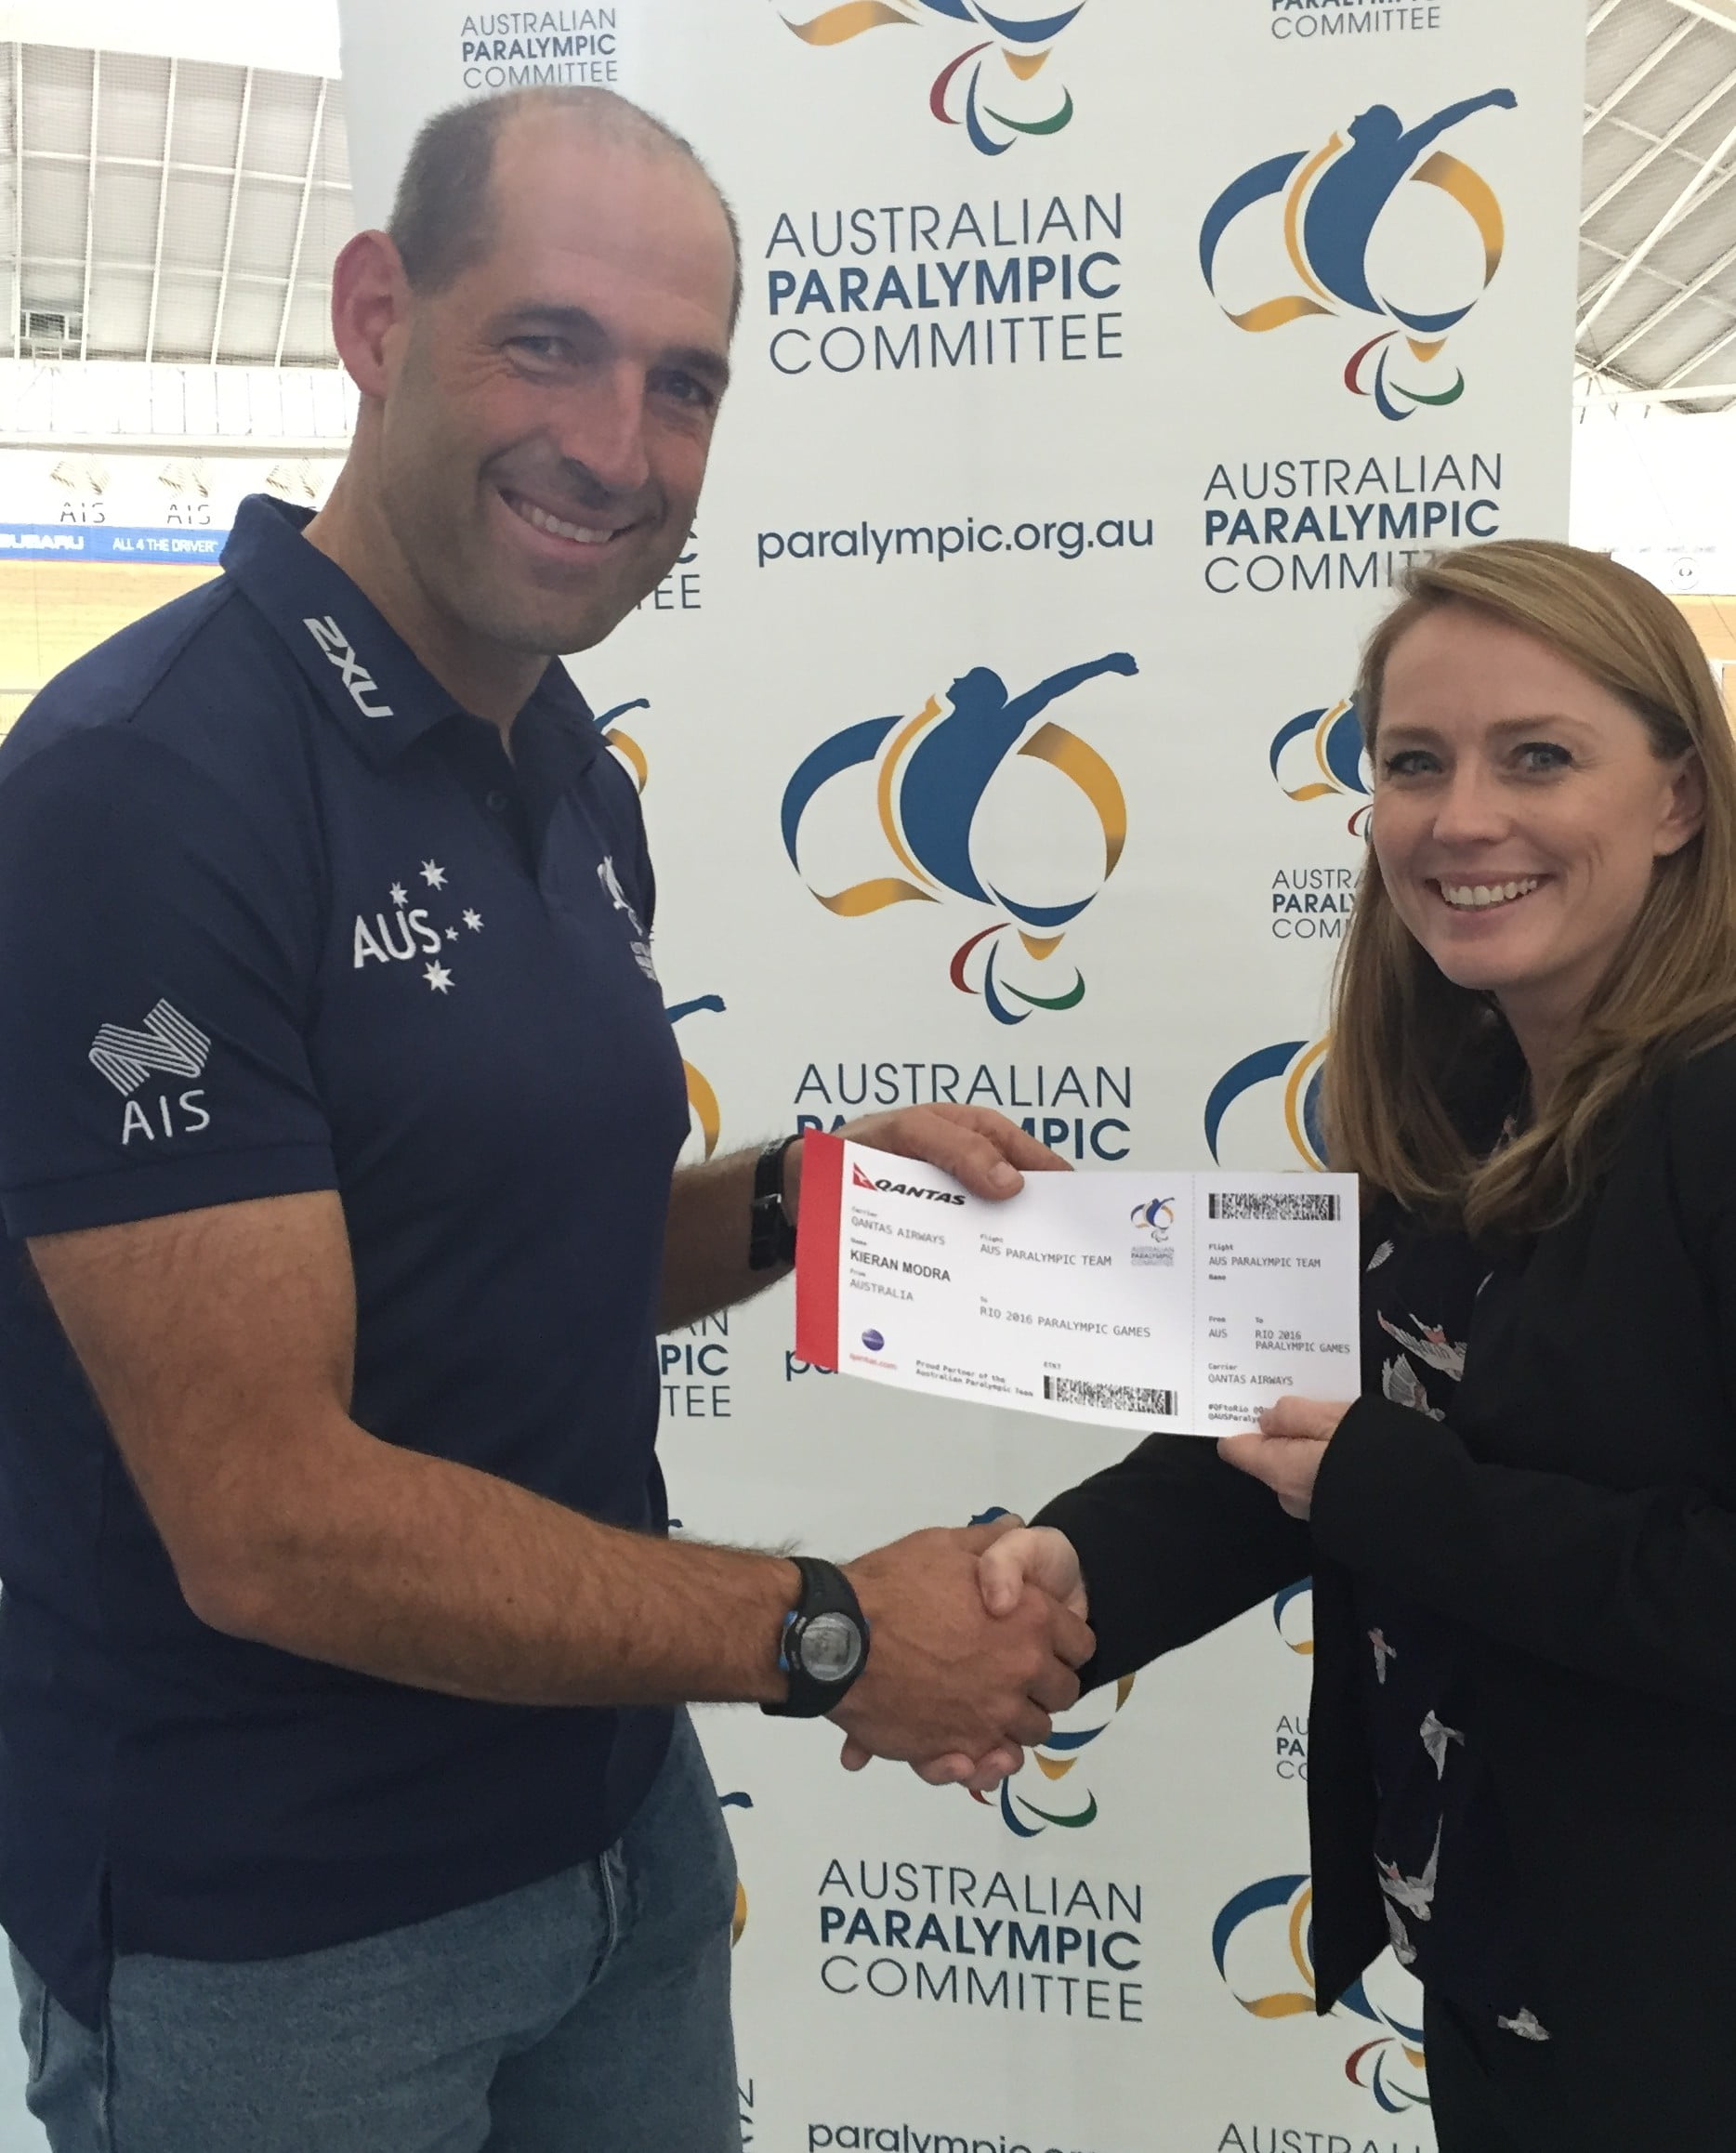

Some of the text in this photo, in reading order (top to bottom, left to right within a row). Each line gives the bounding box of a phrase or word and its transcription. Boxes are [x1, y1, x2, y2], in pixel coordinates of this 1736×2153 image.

[461, 7, 616, 36] AUSTRALIAN
[1271, 7, 1440, 39] COMMITTEE
[462, 33, 617, 62] PARALYMPIC
[463, 60, 618, 89] COMMITTEE
[765, 192, 1122, 258] AUSTRALIAN
[769, 251, 1122, 315] PARALYMPIC
[769, 312, 1123, 374] COMMITTEE
[1203, 453, 1501, 501] AUSTRALIAN
[60, 502, 105, 523] AIS
[167, 505, 211, 525] AIS
[1205, 499, 1500, 546] PARALYMPIC
[112, 537, 133, 551] ALL
[138, 538, 145, 551] 4
[147, 538, 169, 552] THE
[757, 518, 1154, 568] paralympic.org.au
[303, 616, 394, 717] 2XU
[353, 908, 441, 968] AUS
[1272, 918, 1351, 939] COM
[794, 1063, 1131, 1108] AUSTRALIAN
[122, 1089, 210, 1146] AIS
[875, 1179, 966, 1206] QANTAS
[851, 1215, 946, 1245] QANTAS AIRWAYS
[850, 1249, 951, 1282] KIERAN MODRA
[980, 1243, 1111, 1267] AUS PARALYMPIC TEAM
[1209, 1256, 1321, 1267] AUS PARALYMPIC TEAM
[849, 1278, 914, 1302] AUSTRALIA
[980, 1306, 1151, 1338] RIO 2016 PARALYMPIC GAMES
[1209, 1329, 1228, 1338] AUS
[1255, 1330, 1301, 1340] RIO 2016
[1256, 1341, 1350, 1354] PARALYMPIC GAMES
[915, 1359, 940, 1371] Proud
[942, 1364, 975, 1378] Partner
[1208, 1362, 1238, 1371] Carrier
[1208, 1373, 1294, 1385] QANTAS AIRWAYS
[818, 1858, 1141, 1923] AUSTRALIAN
[821, 1906, 1142, 1971] PARALYMPIC
[822, 1955, 1143, 2022] COMMITTEE
